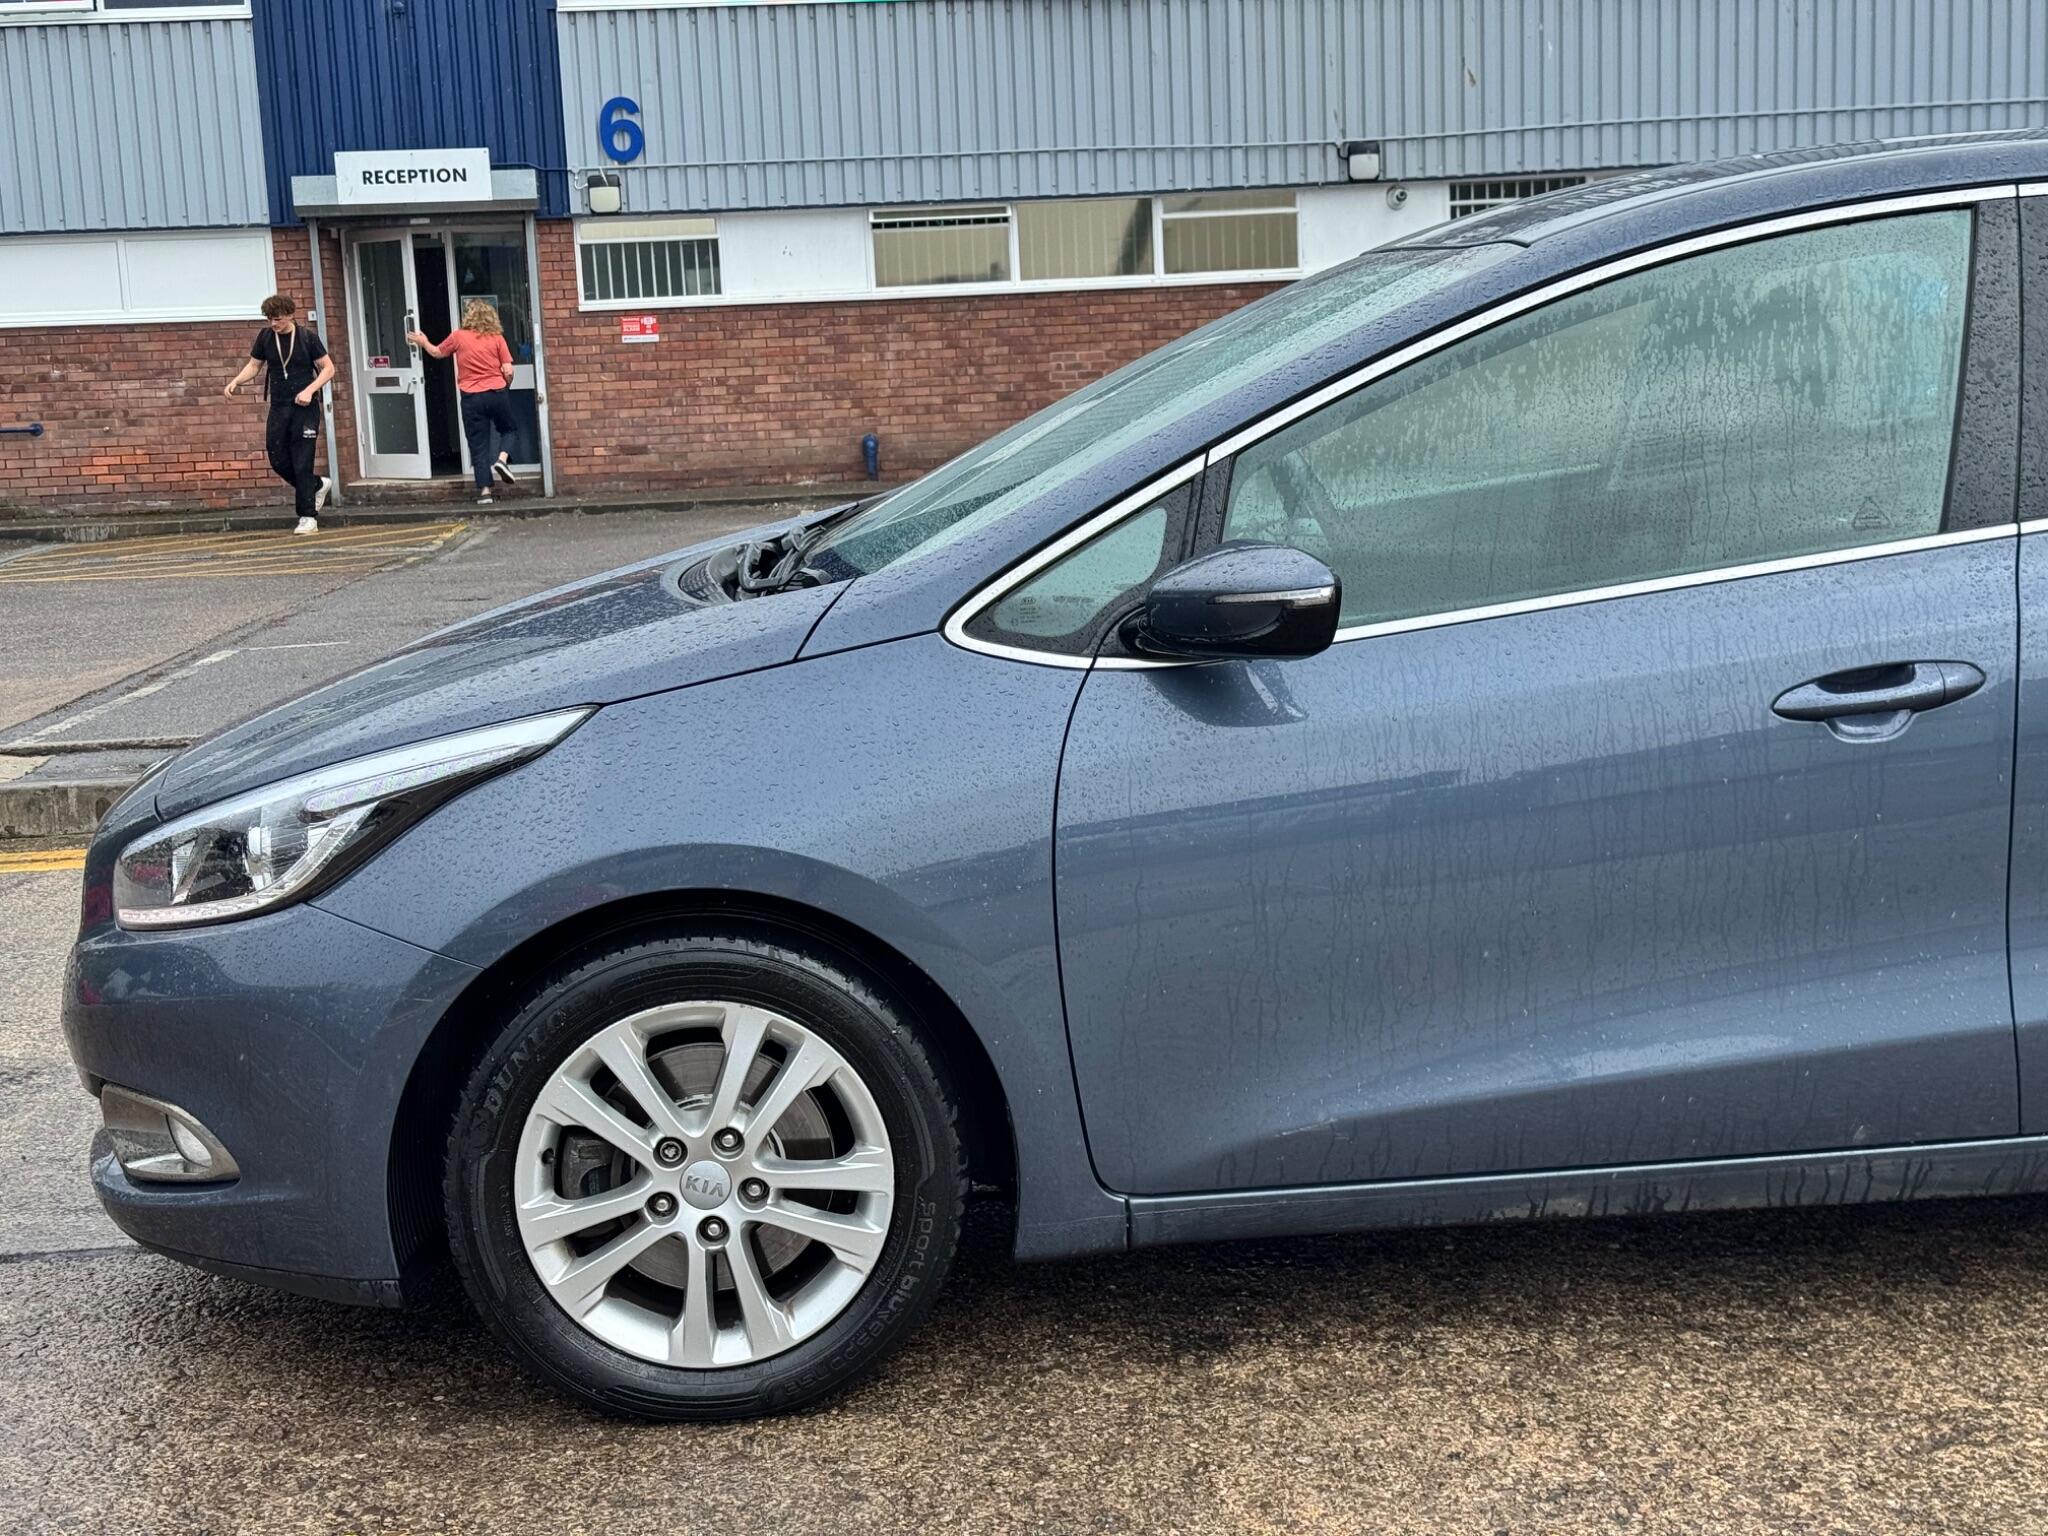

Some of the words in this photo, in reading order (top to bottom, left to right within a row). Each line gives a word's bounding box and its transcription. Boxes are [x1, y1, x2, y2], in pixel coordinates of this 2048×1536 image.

[599, 97, 643, 164] 6
[362, 168, 467, 185] RECEPTION
[685, 1175, 723, 1197] KIA
